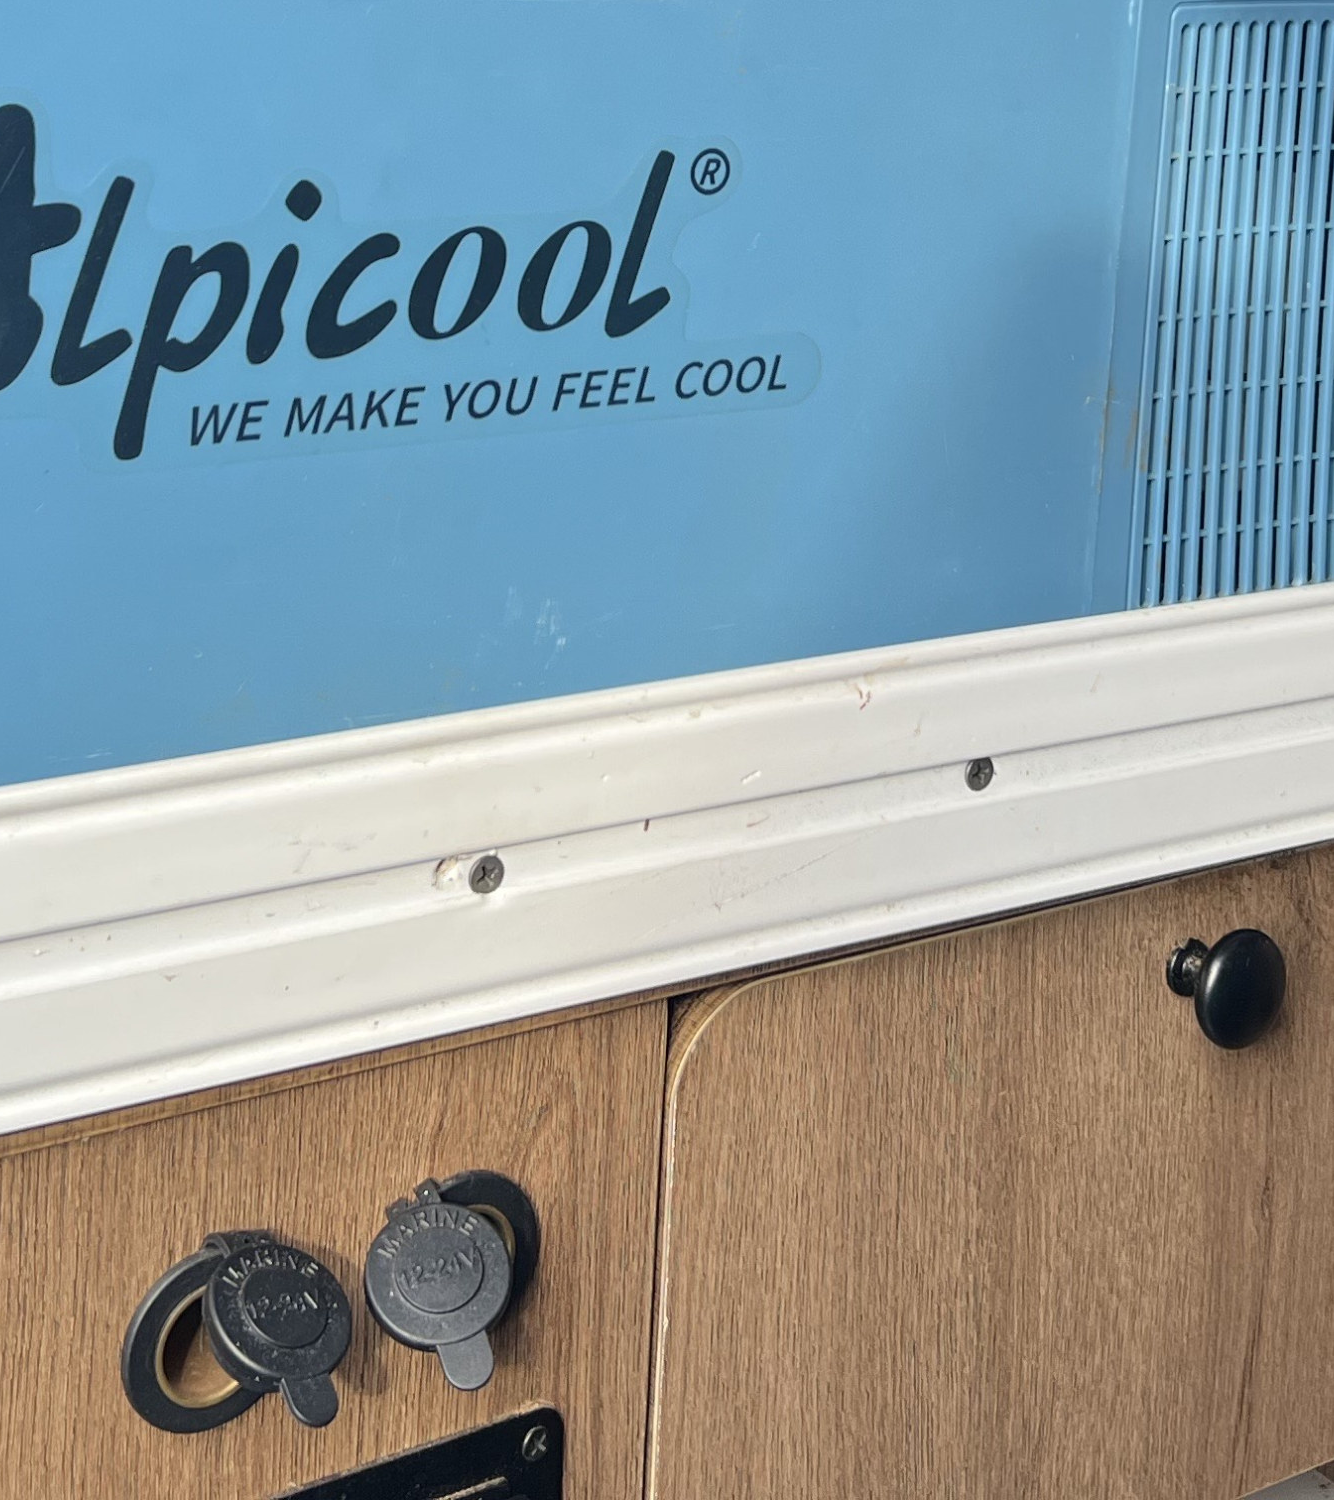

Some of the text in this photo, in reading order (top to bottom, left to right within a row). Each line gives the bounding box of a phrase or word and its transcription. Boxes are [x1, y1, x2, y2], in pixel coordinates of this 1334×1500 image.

[189, 354, 787, 447] WE MAKE YOU FEEL COOL
[376, 1208, 479, 1260] MARINE
[221, 1248, 320, 1288] MARINE
